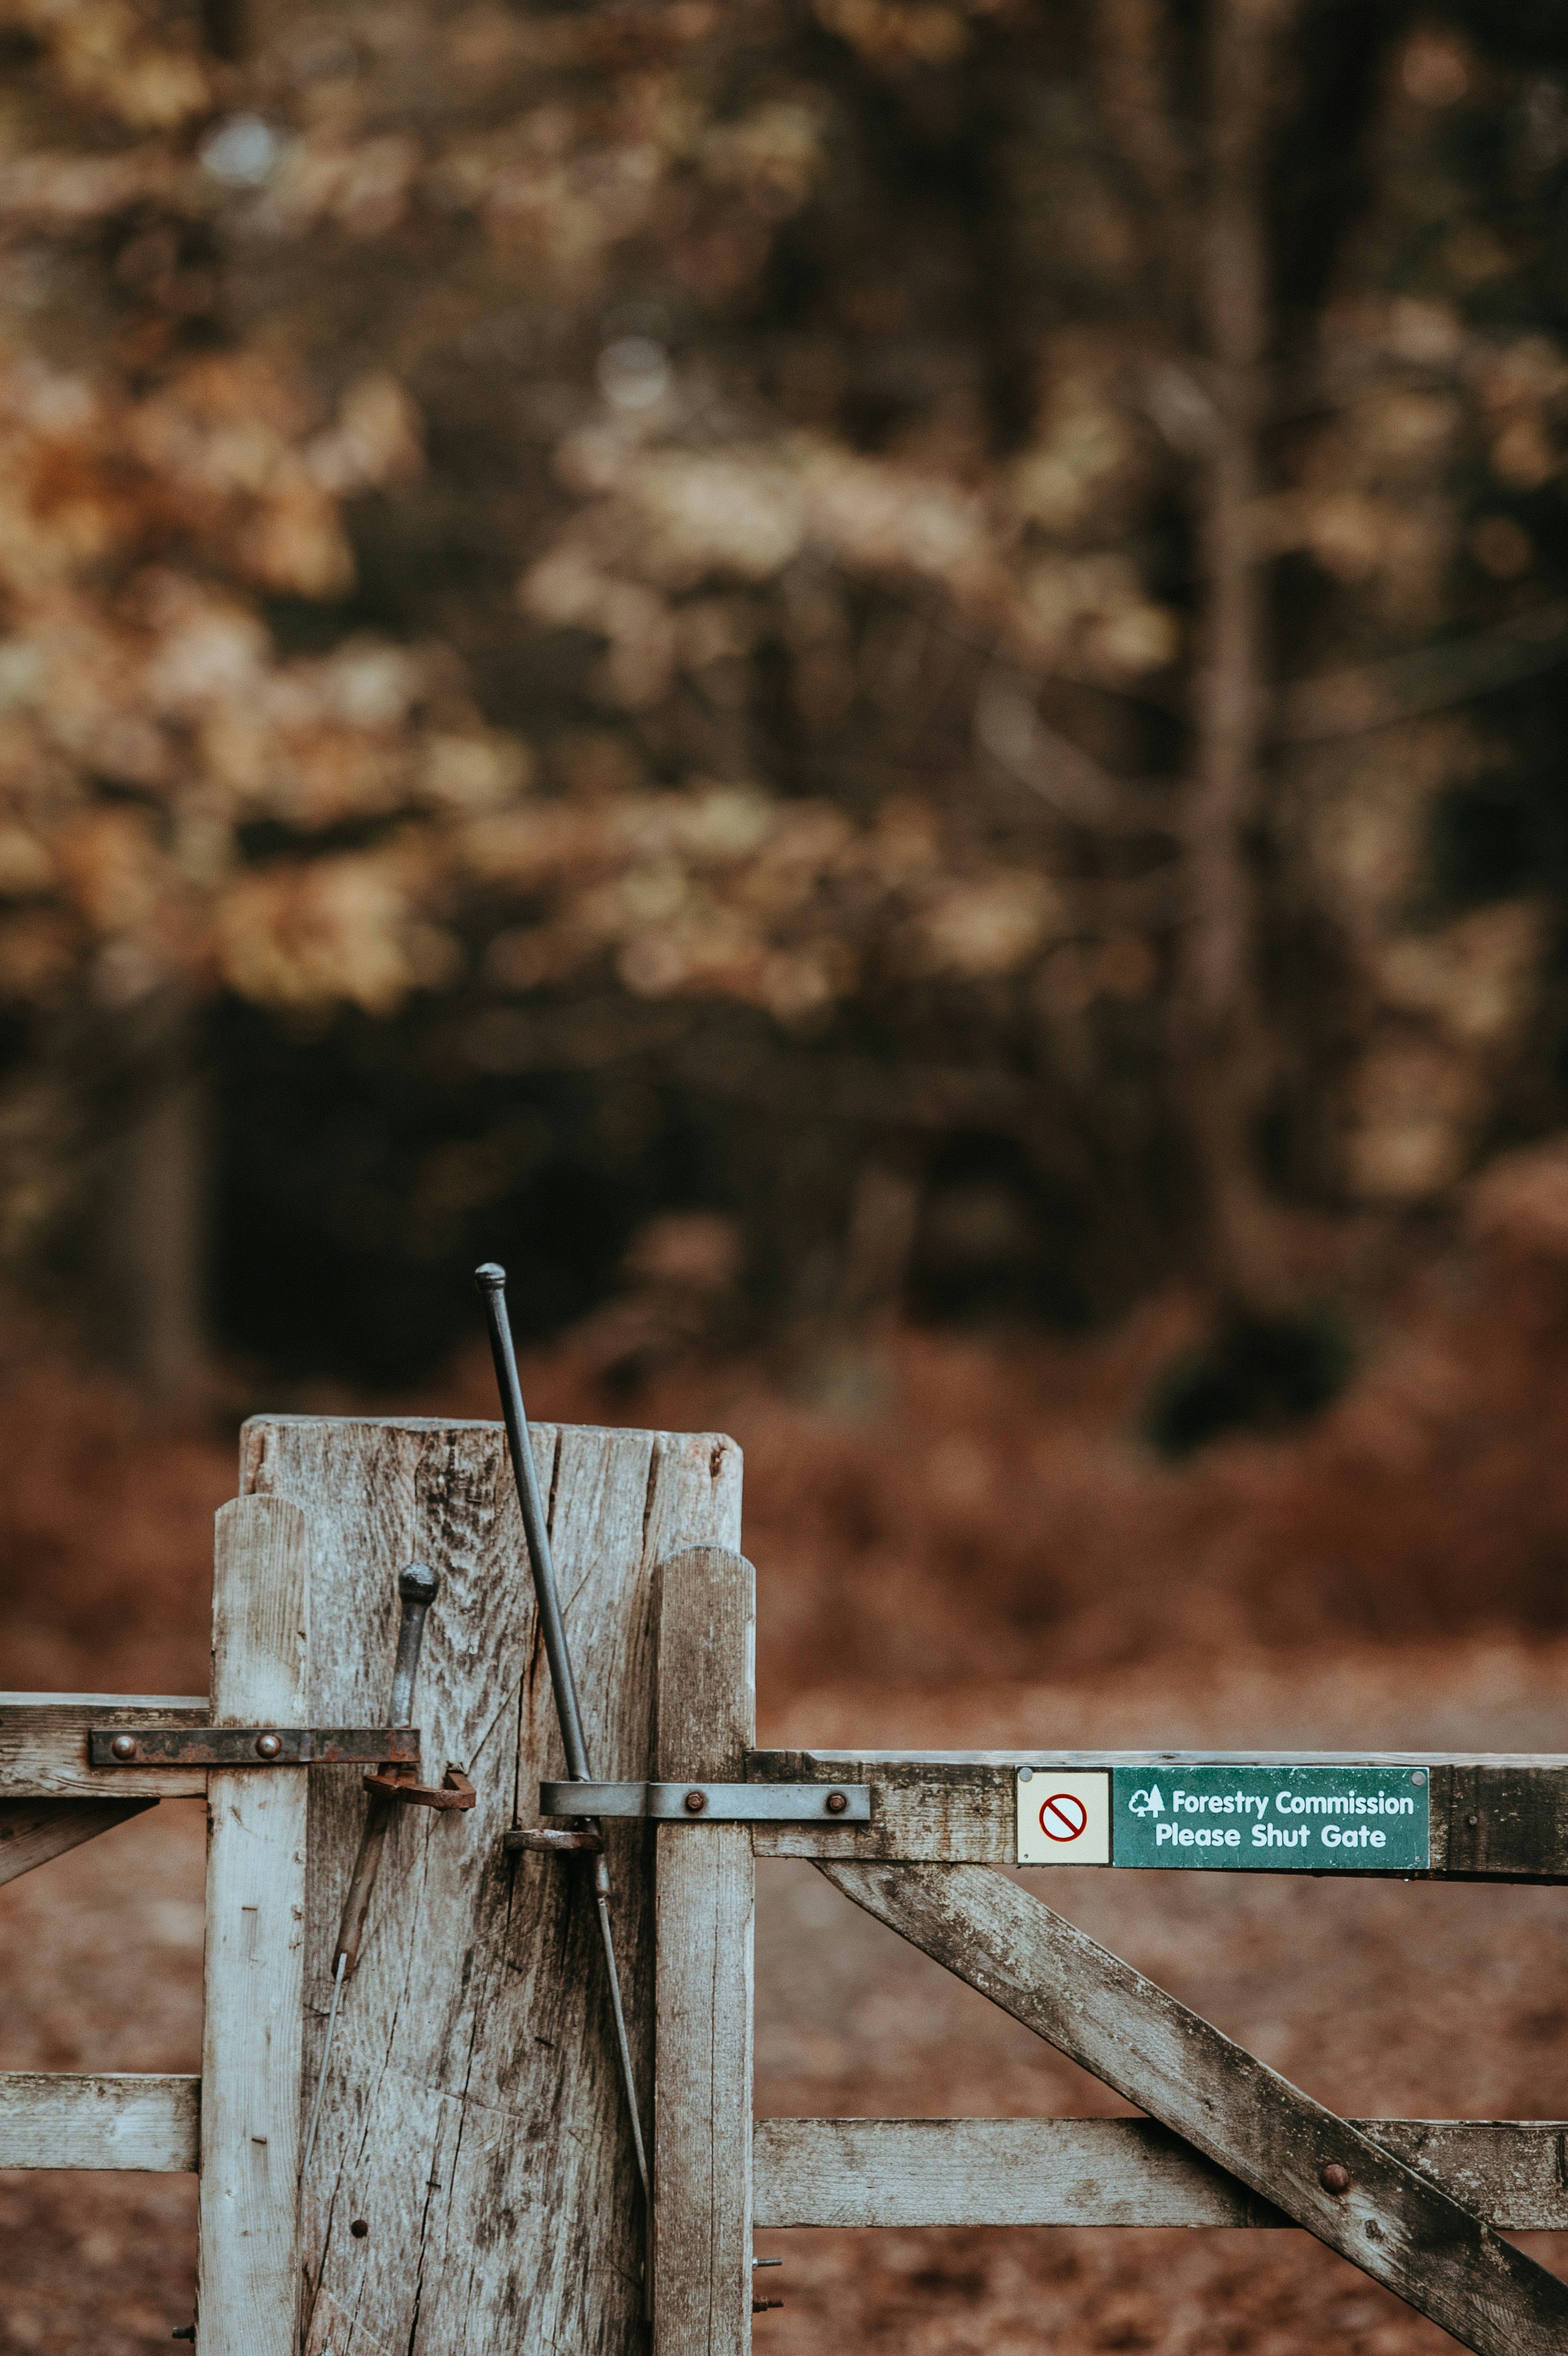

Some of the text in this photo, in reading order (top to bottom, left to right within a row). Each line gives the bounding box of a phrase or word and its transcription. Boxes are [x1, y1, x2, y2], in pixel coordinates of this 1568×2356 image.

[1173, 1790, 1414, 1820] Forestry Commission
[1155, 1822, 1387, 1848] Please Shut Gate
